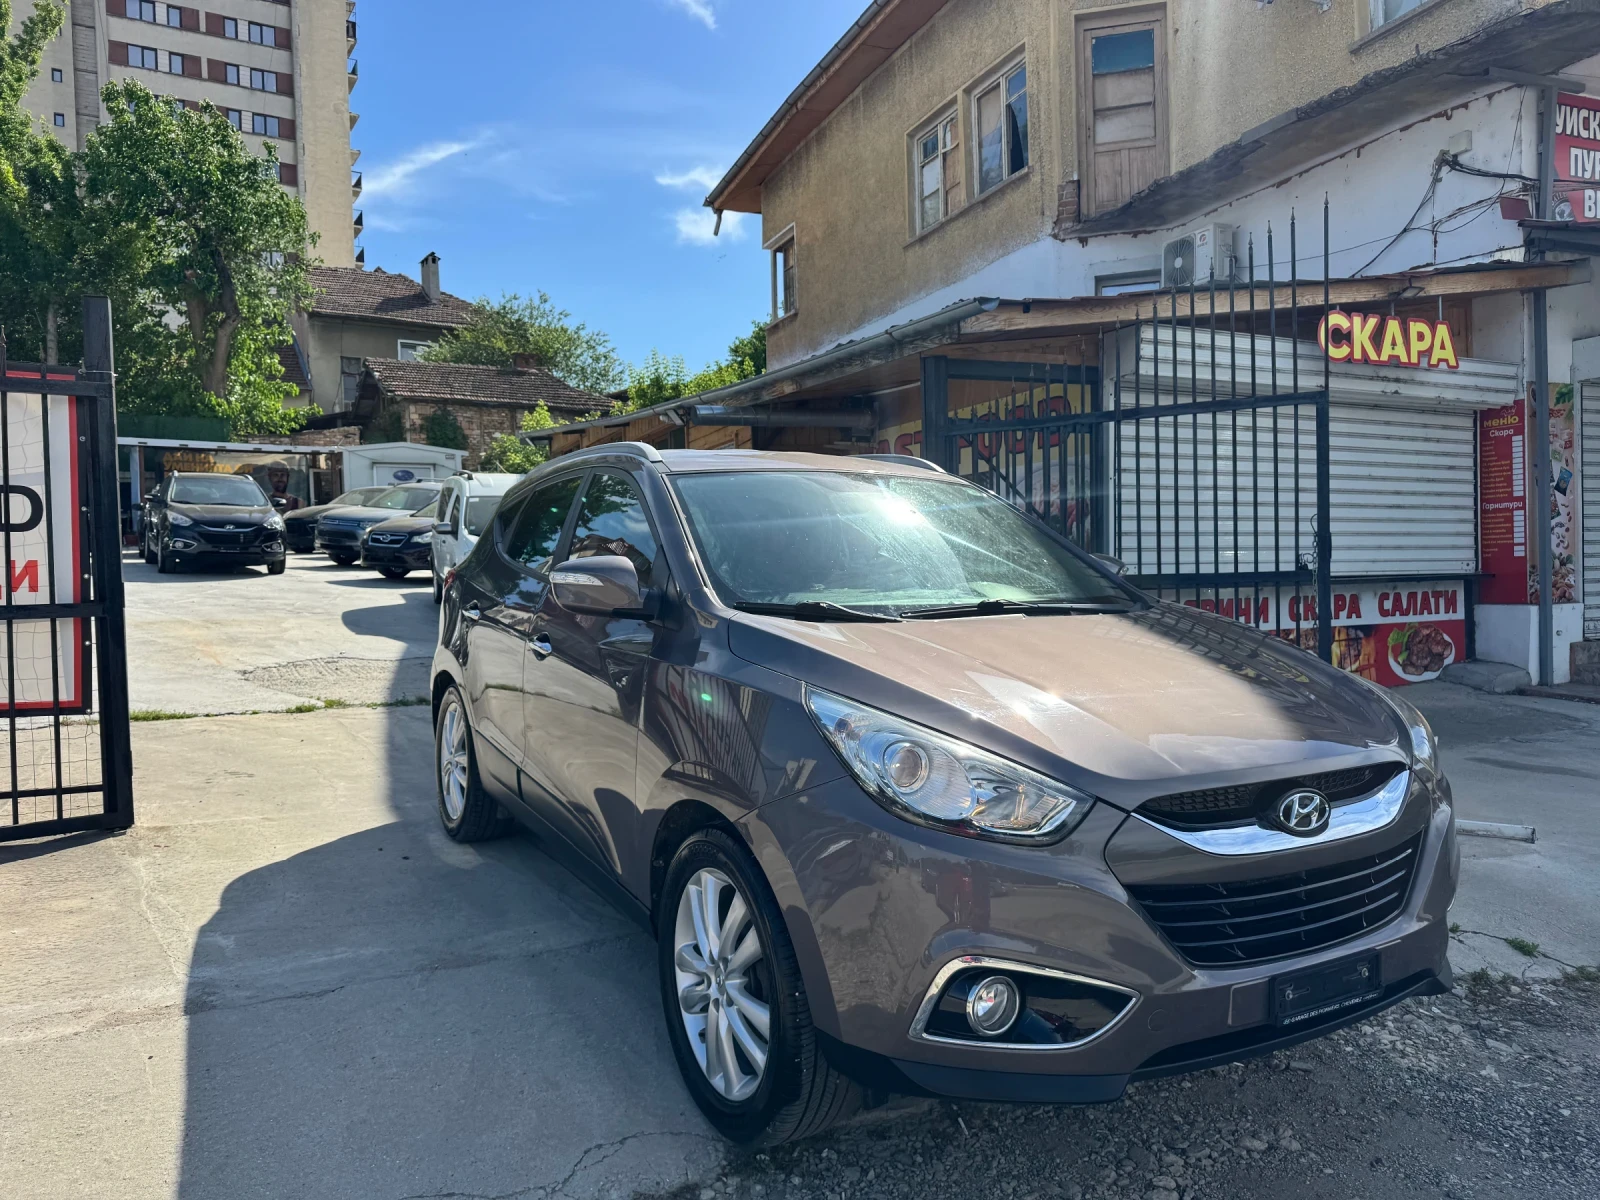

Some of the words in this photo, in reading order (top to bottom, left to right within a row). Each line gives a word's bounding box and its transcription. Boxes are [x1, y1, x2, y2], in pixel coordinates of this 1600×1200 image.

[1584, 189, 1600, 219] В
[1318, 310, 1459, 369] СКАРА
[1482, 501, 1523, 511] Гарнитури
[1288, 592, 1362, 622] СКРА
[1377, 589, 1458, 618] САЛАТИ
